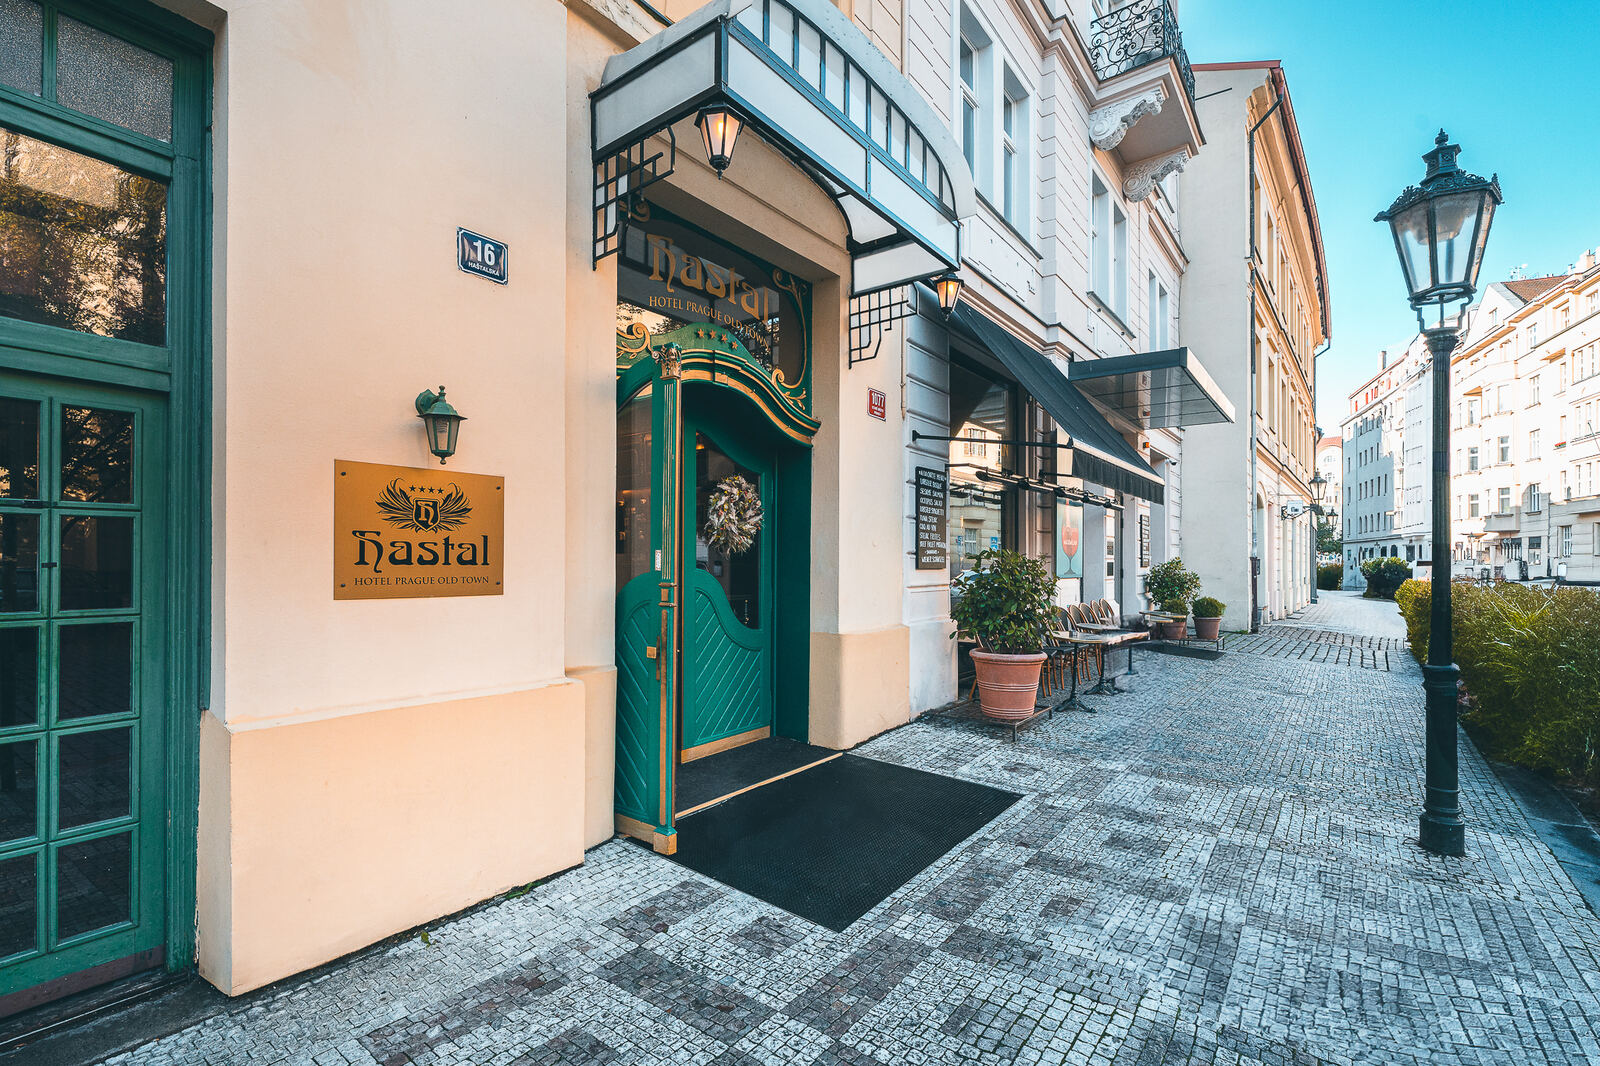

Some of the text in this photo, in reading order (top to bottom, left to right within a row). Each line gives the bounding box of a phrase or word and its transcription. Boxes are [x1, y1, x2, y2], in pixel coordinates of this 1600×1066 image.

[473, 240, 495, 266] 16
[648, 296, 770, 351] HOTEL PRAGUE OLD TOWN
[354, 575, 490, 586] HOTEL PRAGUE OLD TOWN
